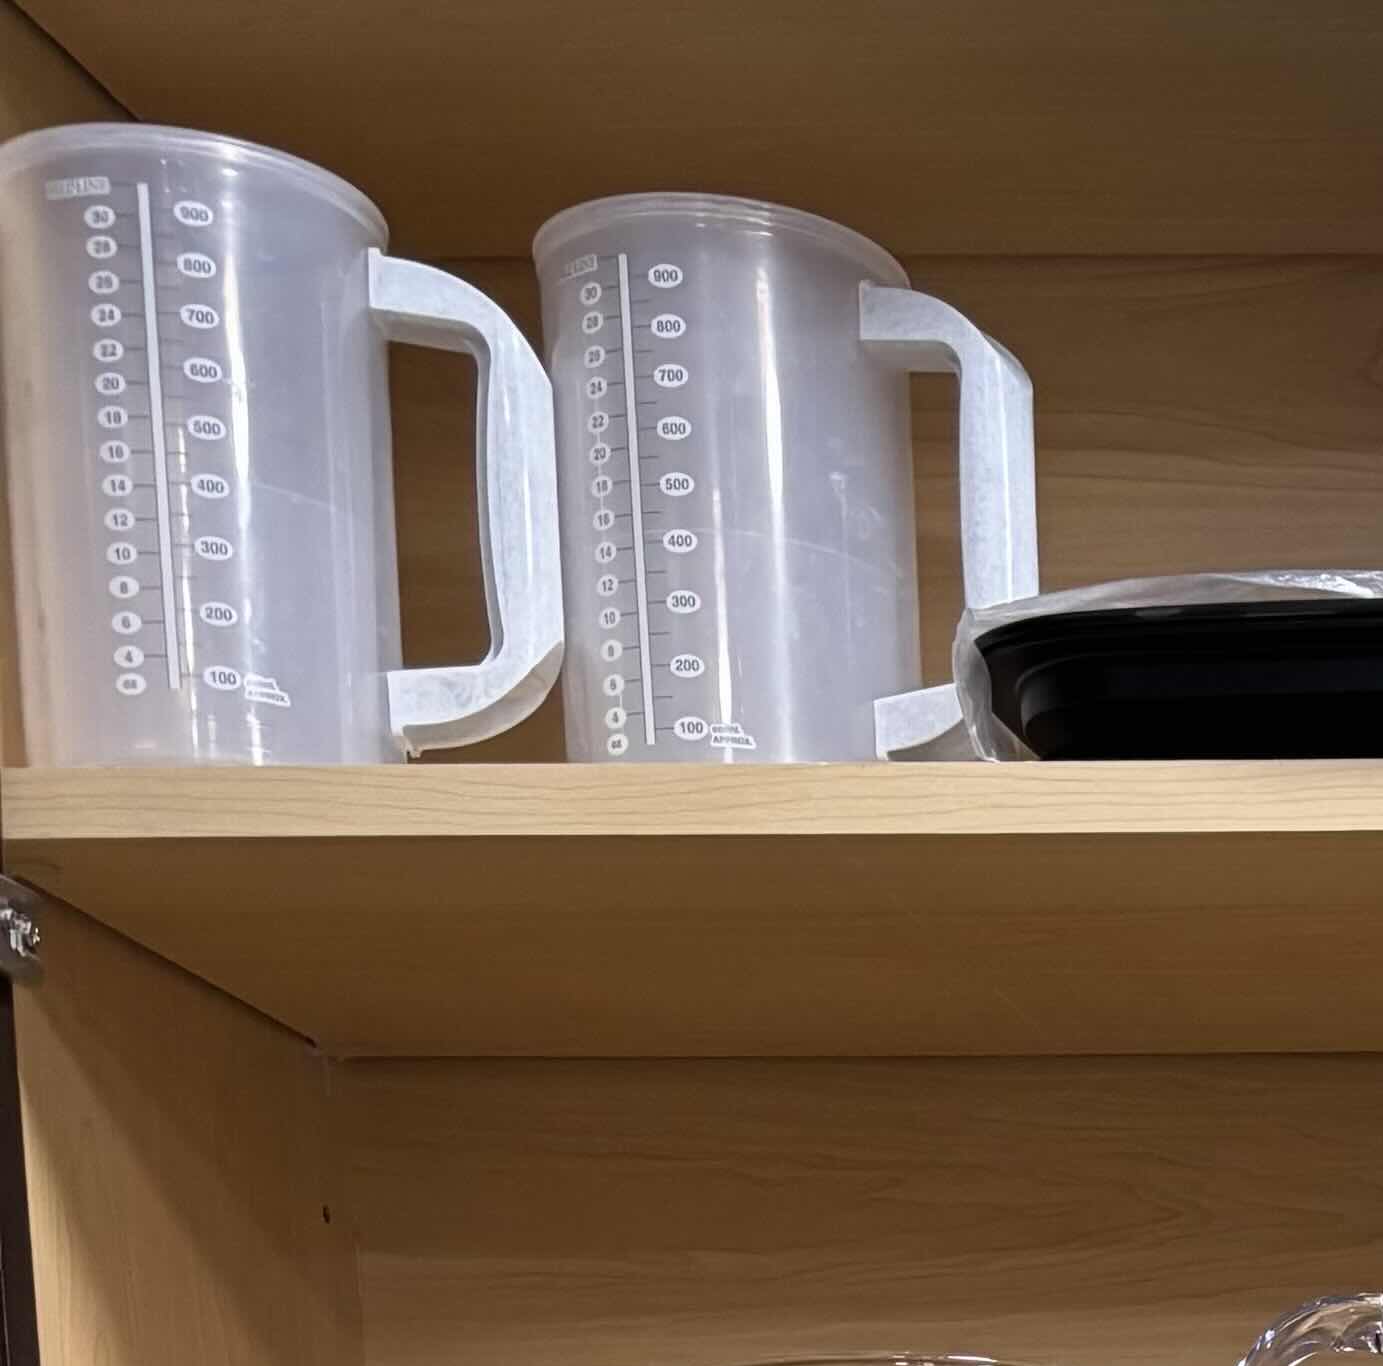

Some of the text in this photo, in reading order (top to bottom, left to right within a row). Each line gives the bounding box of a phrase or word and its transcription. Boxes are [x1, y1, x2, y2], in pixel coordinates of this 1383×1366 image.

[180, 207, 208, 222] 900
[184, 259, 211, 274] 800
[653, 269, 678, 282] 900
[585, 287, 598, 300] 30
[99, 310, 115, 321] 24
[188, 309, 214, 324] 700
[657, 319, 681, 332] 800
[101, 345, 117, 356] 22
[190, 363, 217, 378] 600
[659, 369, 683, 383] 700
[102, 378, 119, 389] 20
[589, 381, 602, 394] 24
[106, 412, 121, 423] 18
[591, 415, 604, 428] 22
[193, 421, 221, 435] 500
[662, 422, 686, 435] 600
[109, 446, 124, 458] 16
[593, 448, 606, 460] 20
[110, 480, 126, 492] 14
[197, 478, 224, 493] 400
[596, 480, 609, 493] 18
[665, 478, 690, 491] 500
[113, 513, 128, 525] 12
[598, 514, 610, 527] 16
[668, 535, 693, 548] 400
[115, 548, 131, 560] 10
[200, 541, 228, 556] 300
[600, 546, 613, 560] 14
[602, 579, 614, 591] 12
[671, 595, 696, 608] 300
[205, 608, 232, 622] 200
[604, 611, 616, 625] 10
[675, 659, 700, 672] 200
[210, 671, 237, 685] 100
[679, 721, 704, 734] 100
